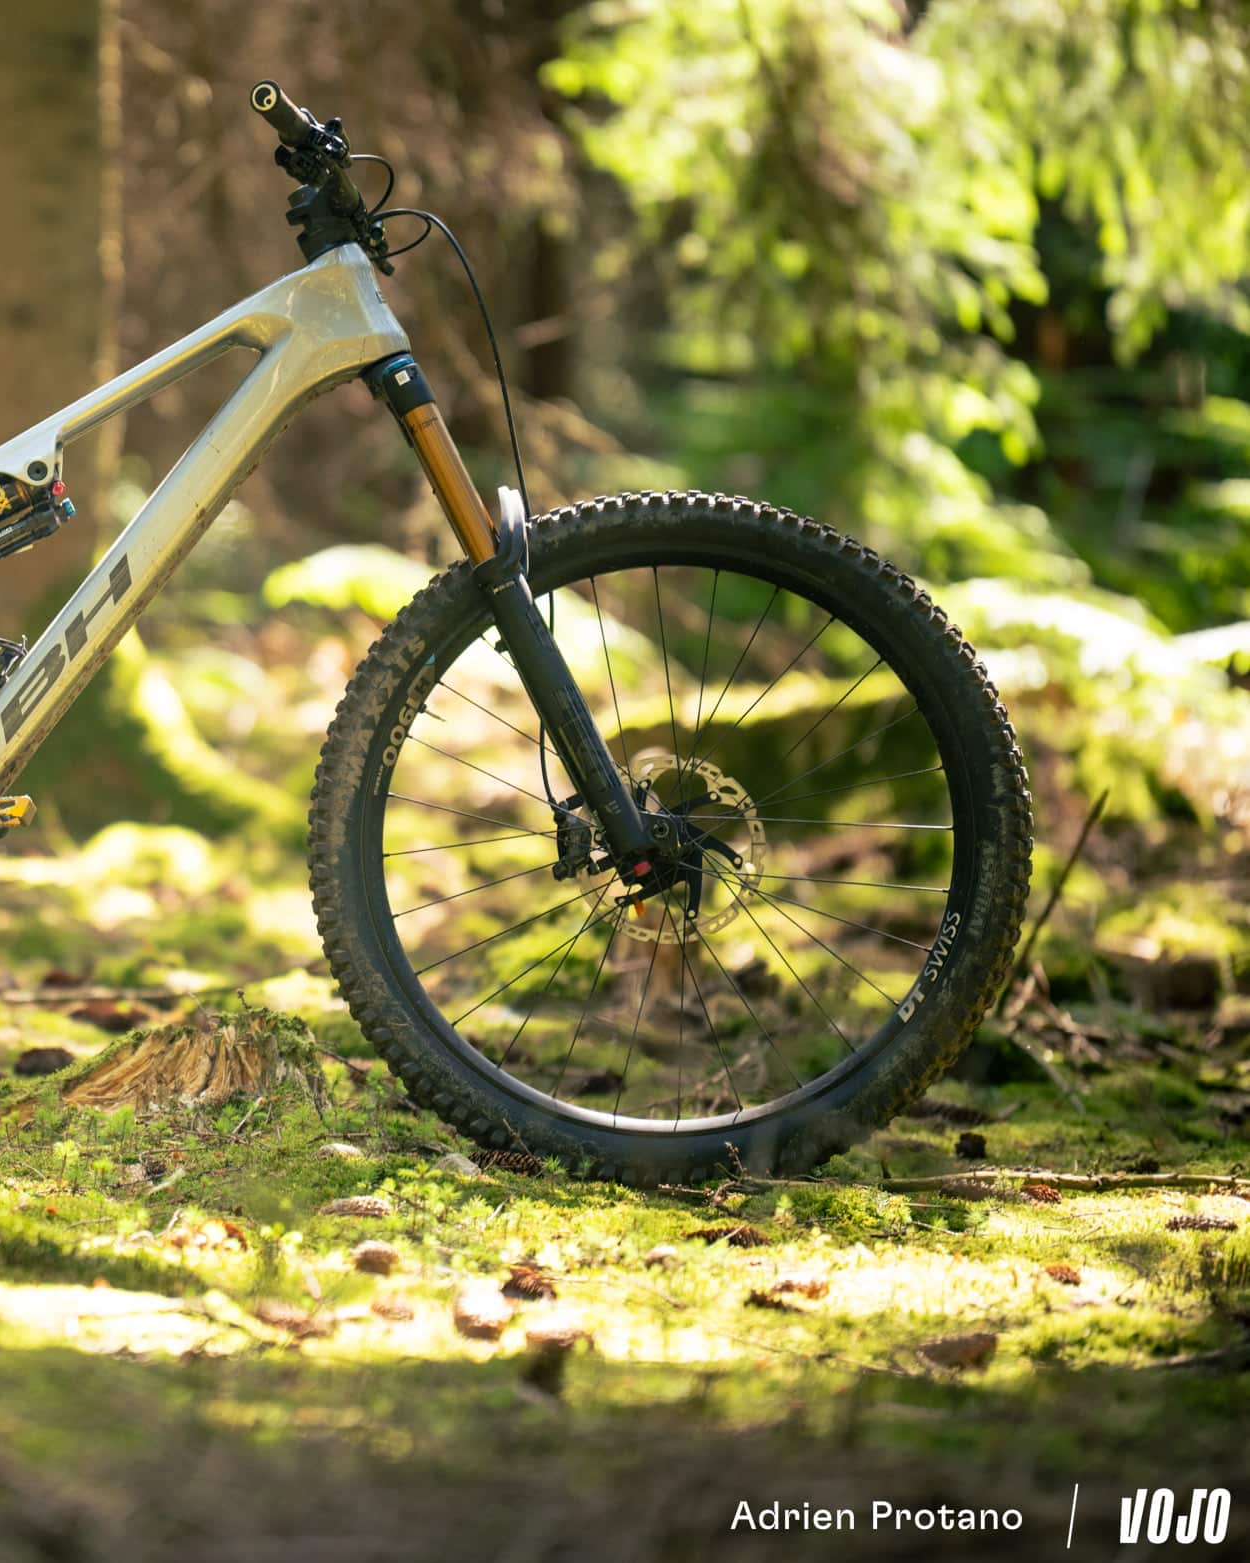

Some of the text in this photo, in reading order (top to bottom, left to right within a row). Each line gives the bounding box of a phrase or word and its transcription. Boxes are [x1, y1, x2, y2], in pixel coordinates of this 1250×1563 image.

[1, 553, 132, 744] BH
[897, 911, 961, 1024] DT SWISS
